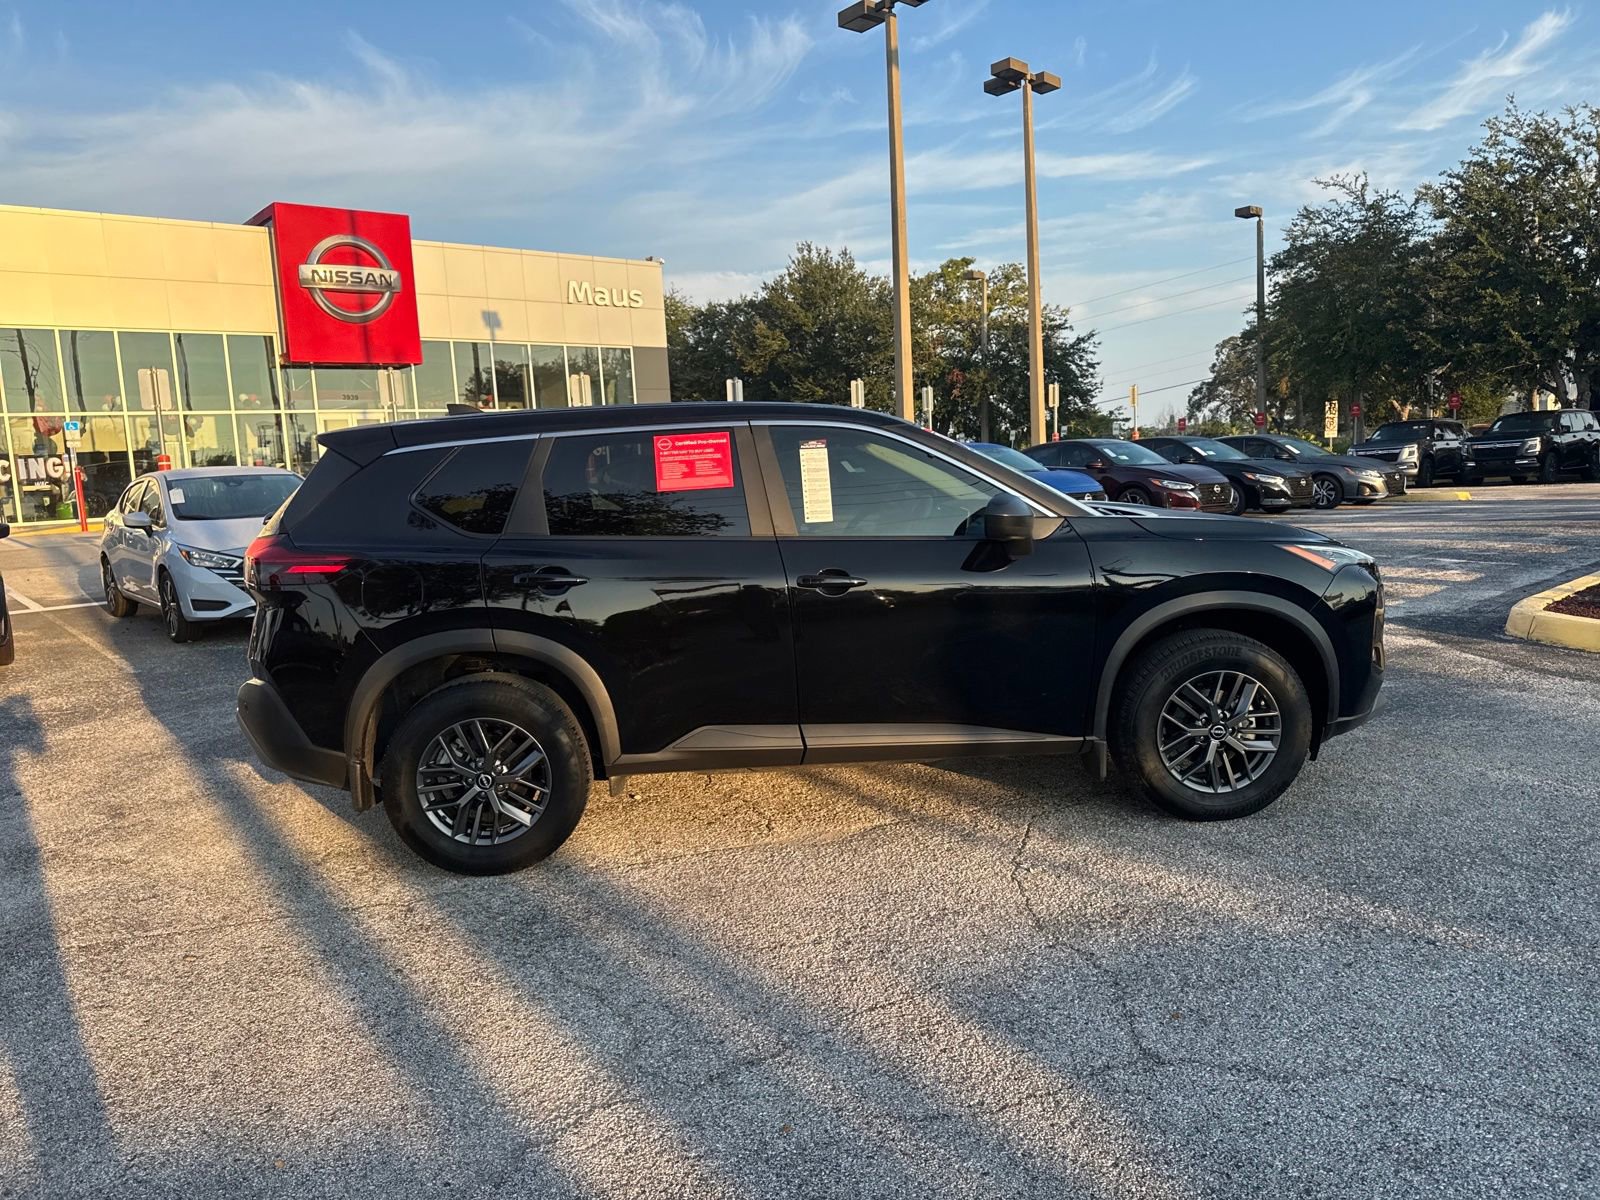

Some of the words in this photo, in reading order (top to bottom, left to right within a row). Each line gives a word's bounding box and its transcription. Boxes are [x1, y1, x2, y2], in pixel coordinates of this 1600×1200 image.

[311, 269, 393, 286] NISSAN
[567, 280, 644, 308] Maus
[1160, 646, 1242, 681] BRIDGESTONE
